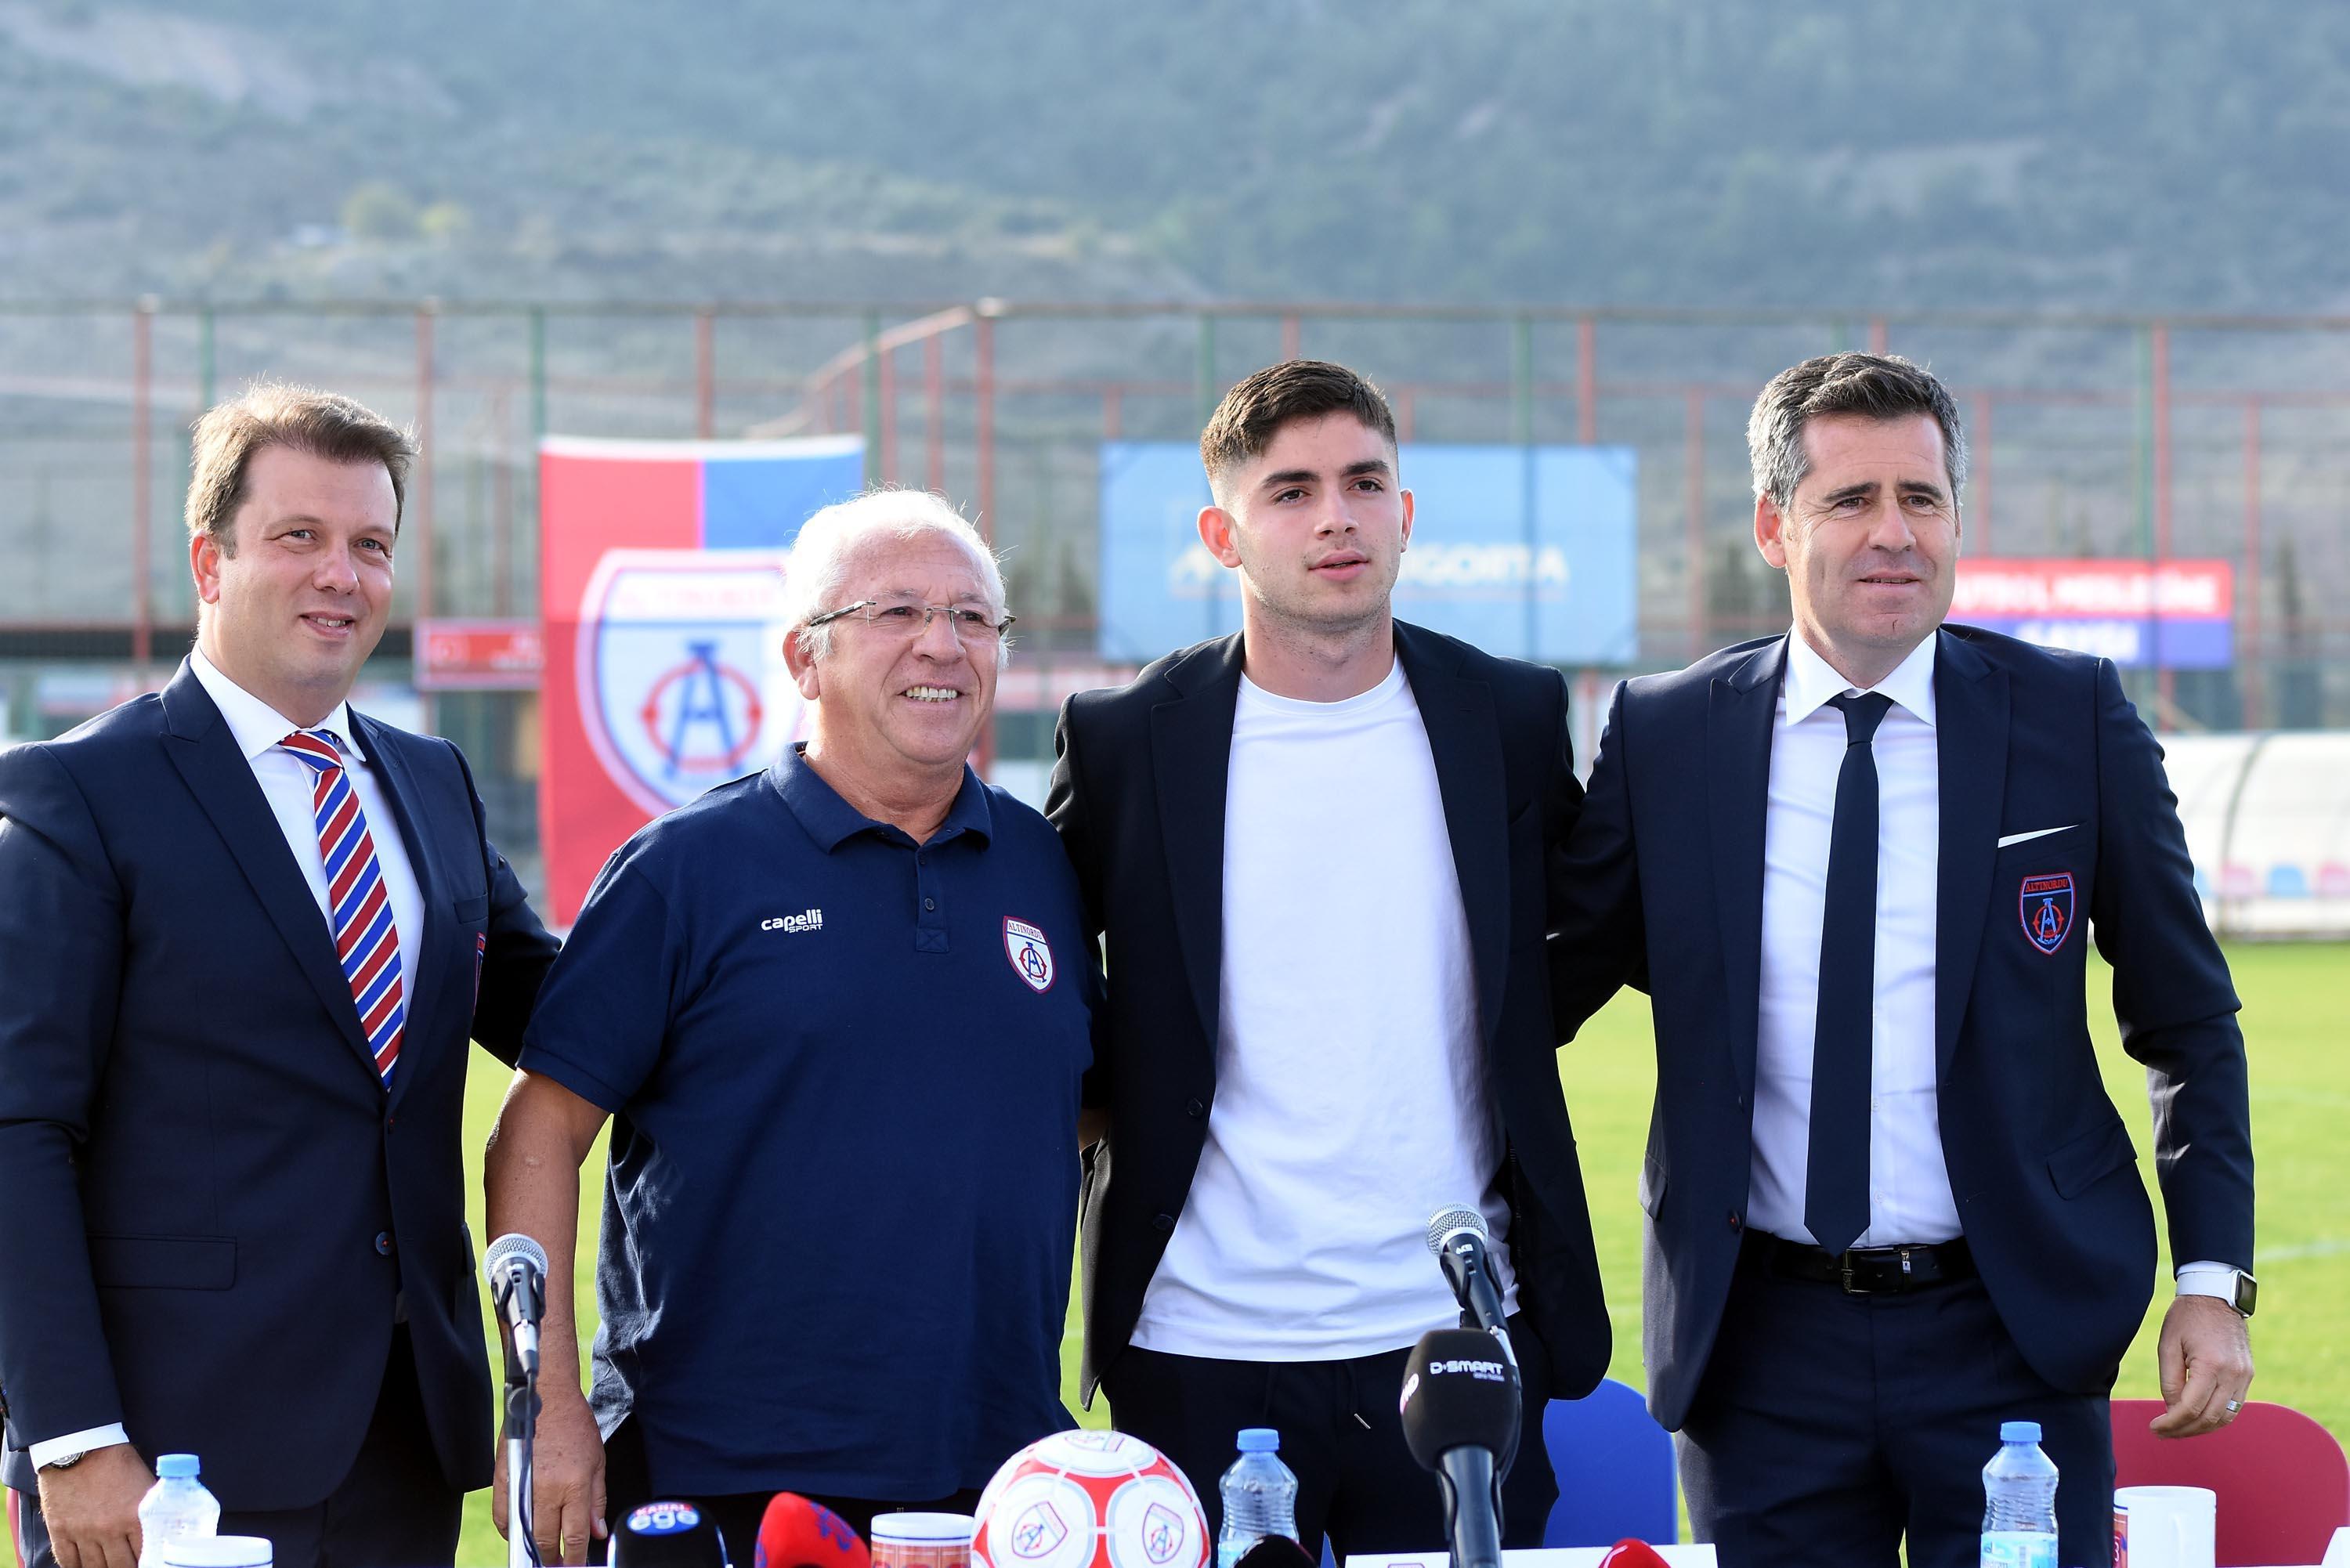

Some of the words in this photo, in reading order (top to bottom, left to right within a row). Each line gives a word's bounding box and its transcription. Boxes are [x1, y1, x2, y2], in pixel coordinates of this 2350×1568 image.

[2025, 879, 2068, 892] ALTINORDU
[761, 909, 823, 932] capelli
[788, 923, 823, 934] SPORT
[1008, 922, 1043, 940] ALTINORDU
[629, 1510, 699, 1530] ege
